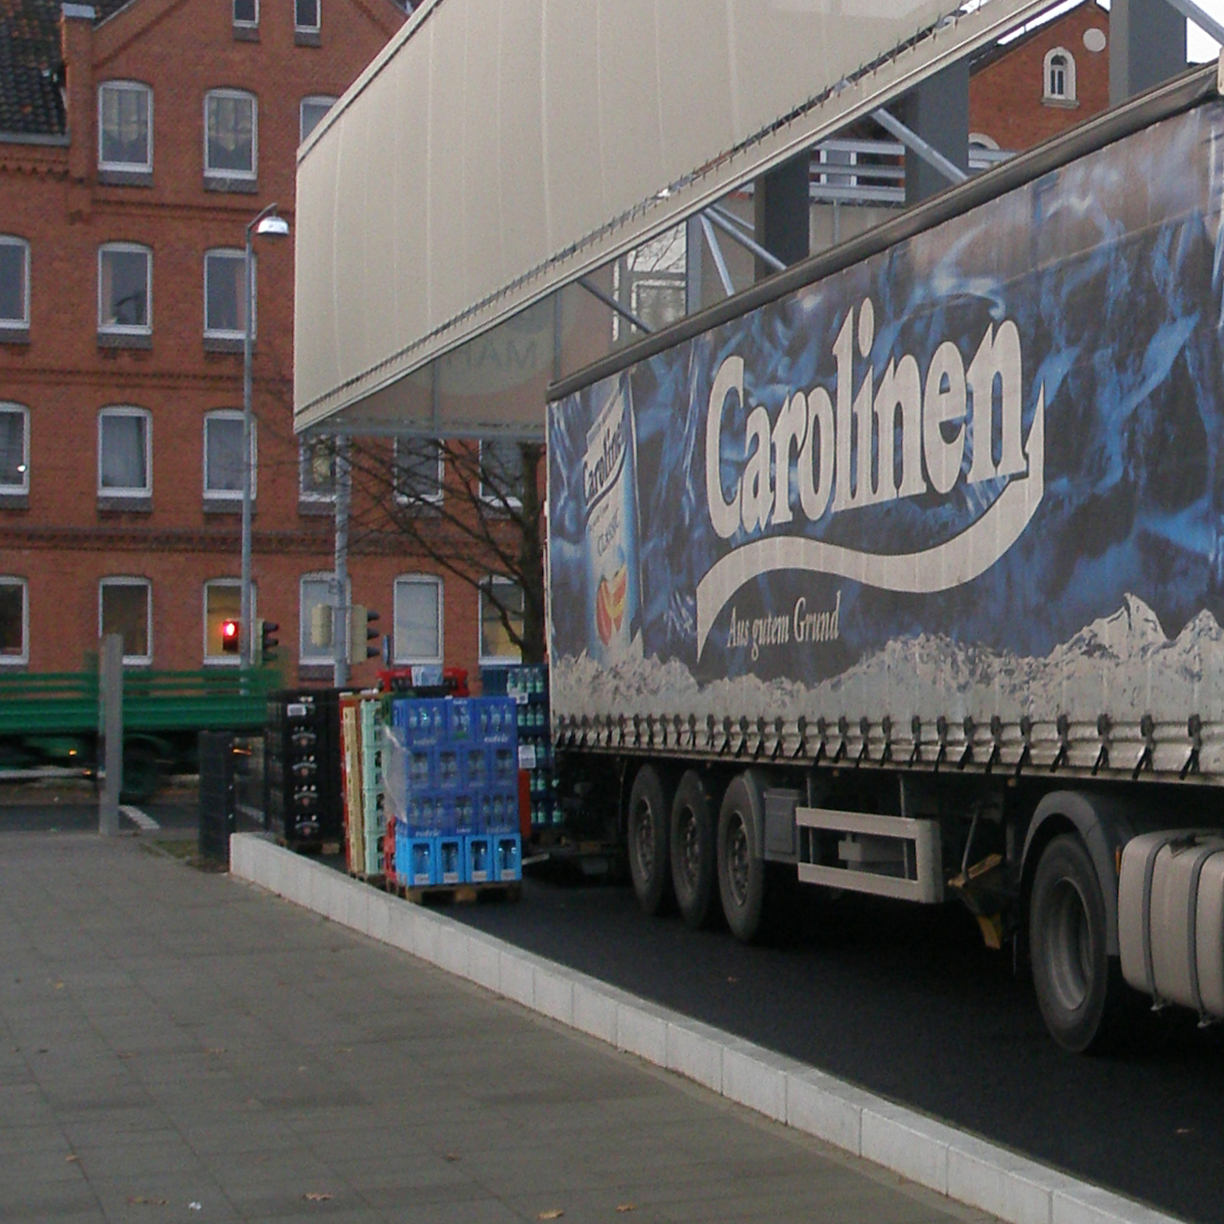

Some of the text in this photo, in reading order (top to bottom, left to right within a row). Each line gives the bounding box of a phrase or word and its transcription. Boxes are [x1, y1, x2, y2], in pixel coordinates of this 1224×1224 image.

[706, 297, 1027, 539] Carolinen
[726, 589, 842, 662] Aus gutem Grund
